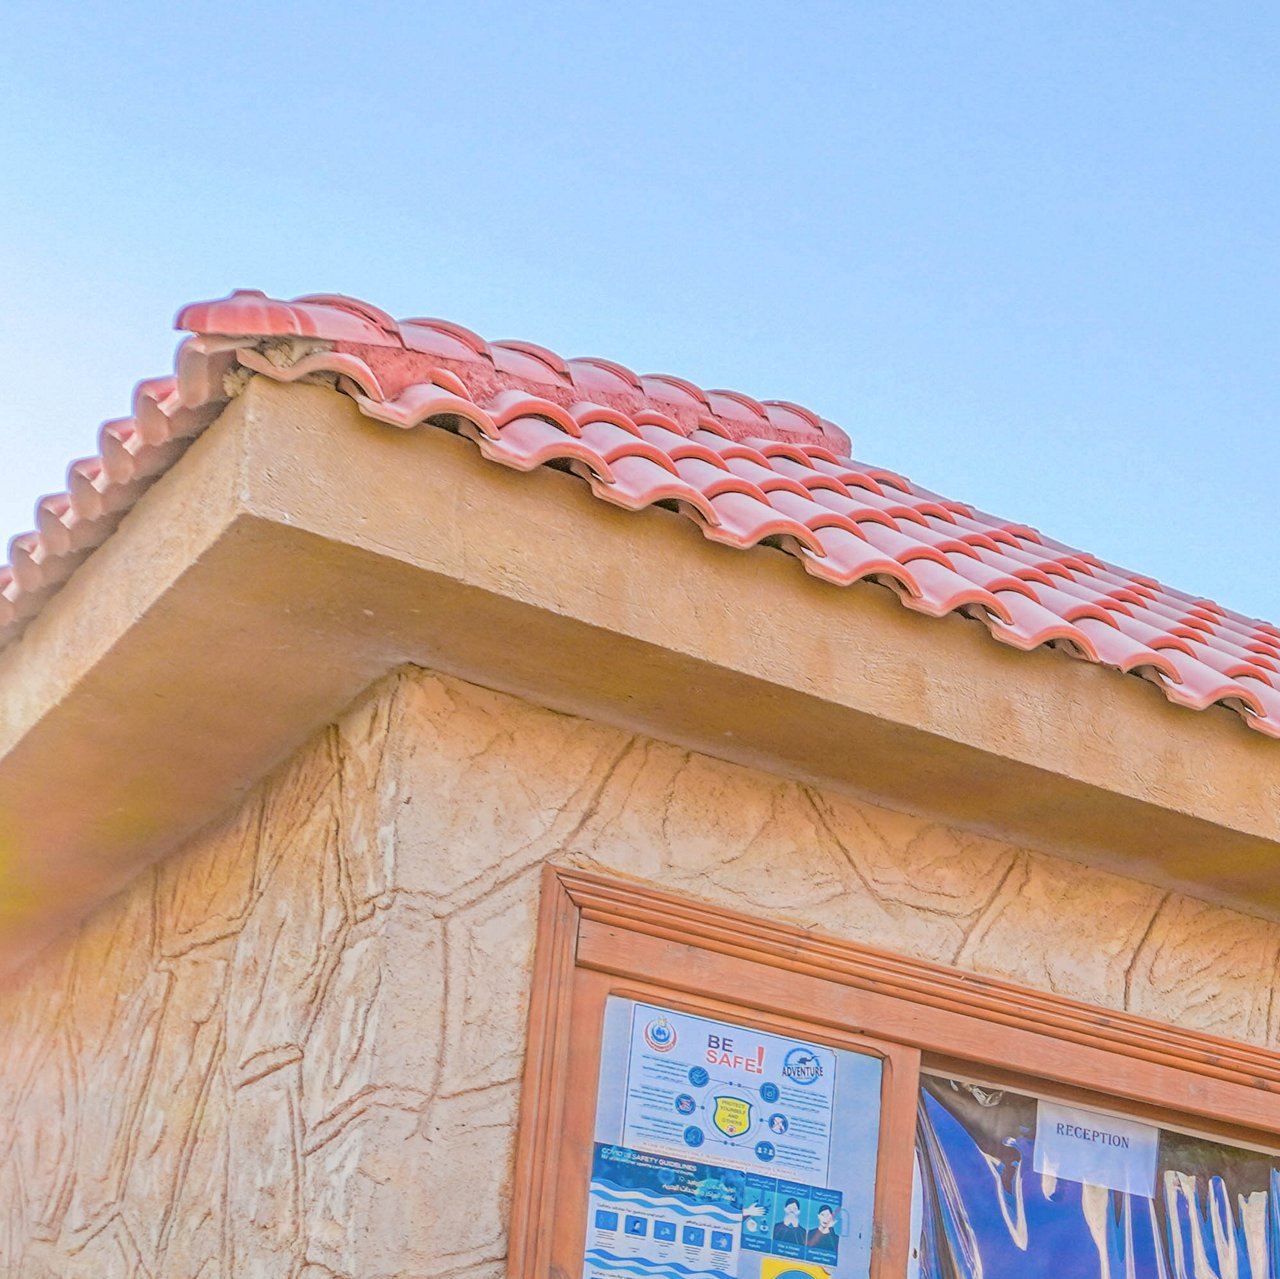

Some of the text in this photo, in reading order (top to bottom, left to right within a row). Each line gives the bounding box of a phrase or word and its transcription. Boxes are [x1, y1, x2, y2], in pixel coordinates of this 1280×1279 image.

[707, 1034, 734, 1053] BE
[705, 1046, 765, 1074] SAFE!
[782, 1066, 823, 1077] ADVENTURE
[1056, 1122, 1129, 1149] RECEPTION
